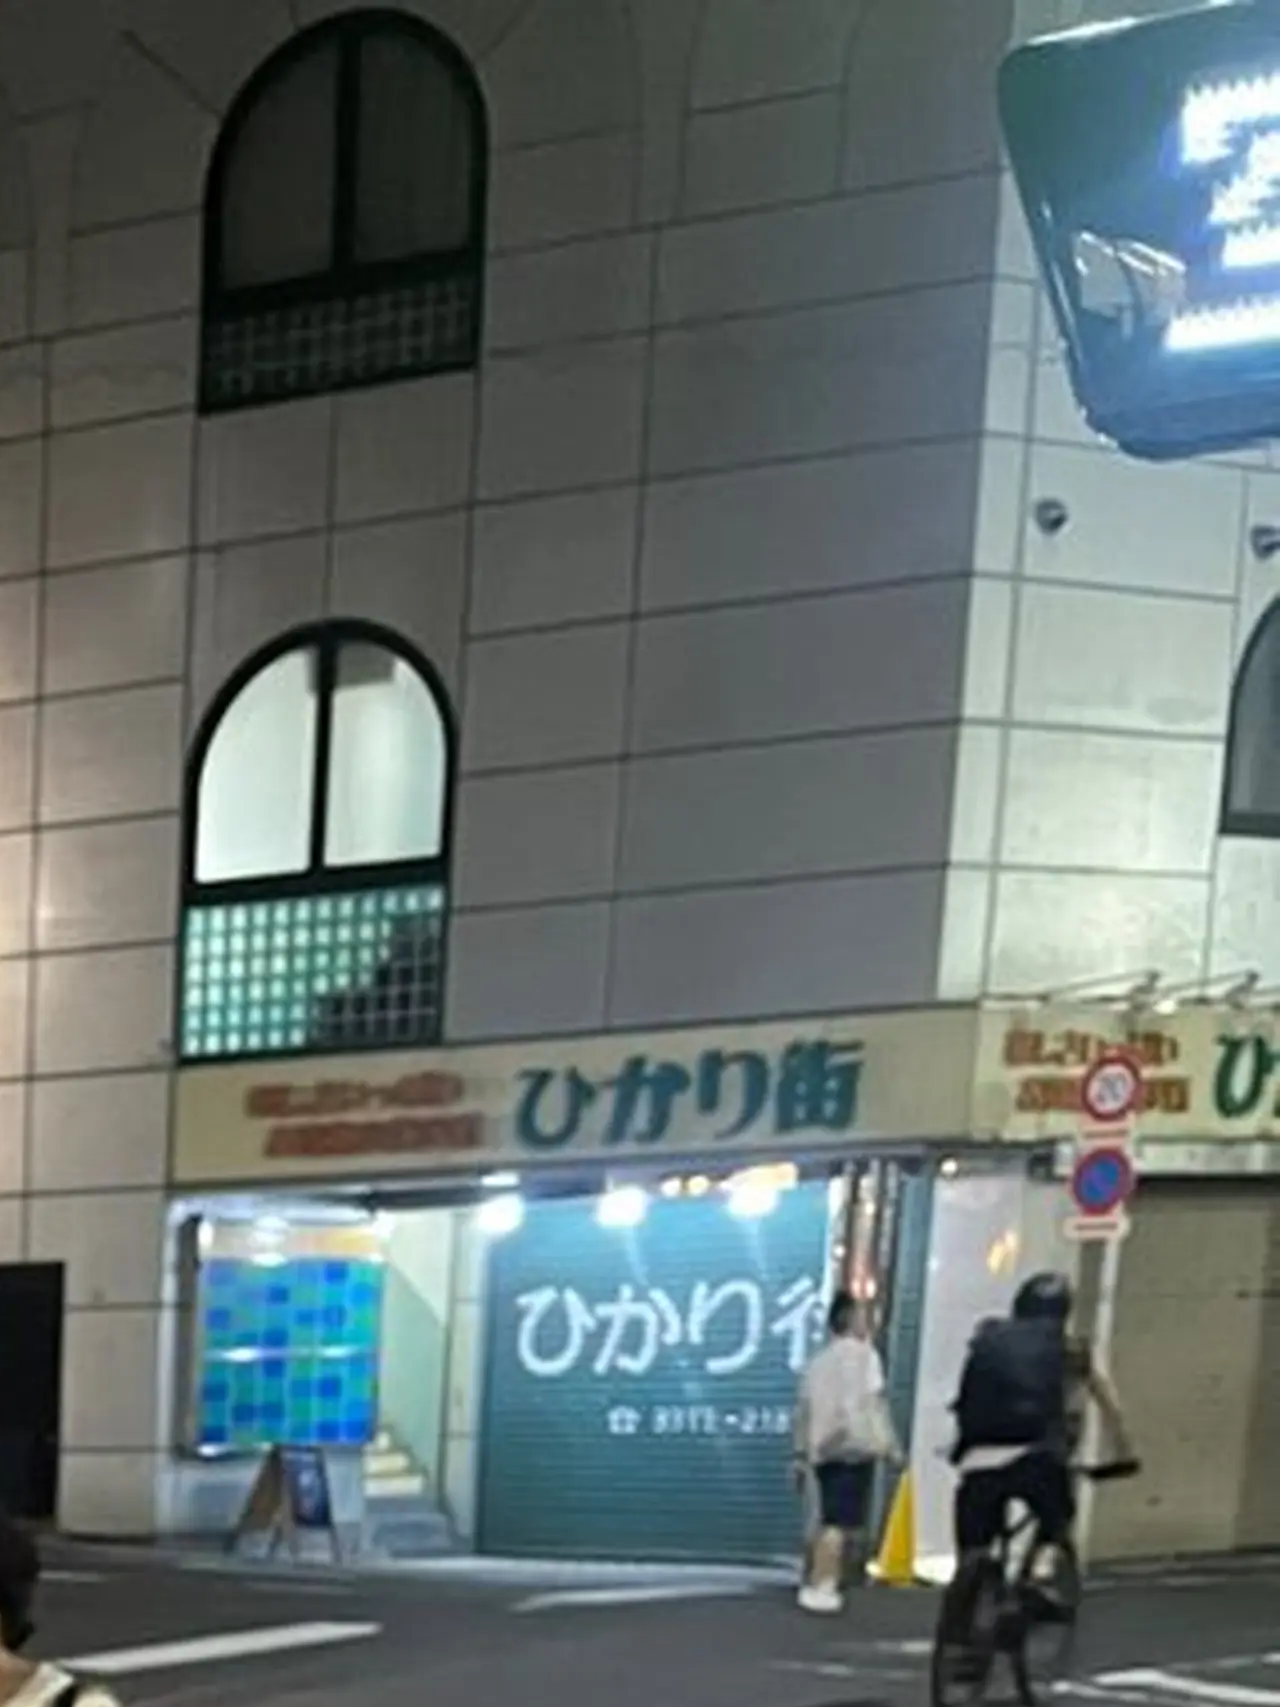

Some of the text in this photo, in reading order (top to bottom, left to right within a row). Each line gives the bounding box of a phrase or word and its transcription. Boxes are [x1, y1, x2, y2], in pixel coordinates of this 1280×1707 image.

[515, 1039, 866, 1151] ひかり街
[1213, 1032, 1280, 1120] ひ
